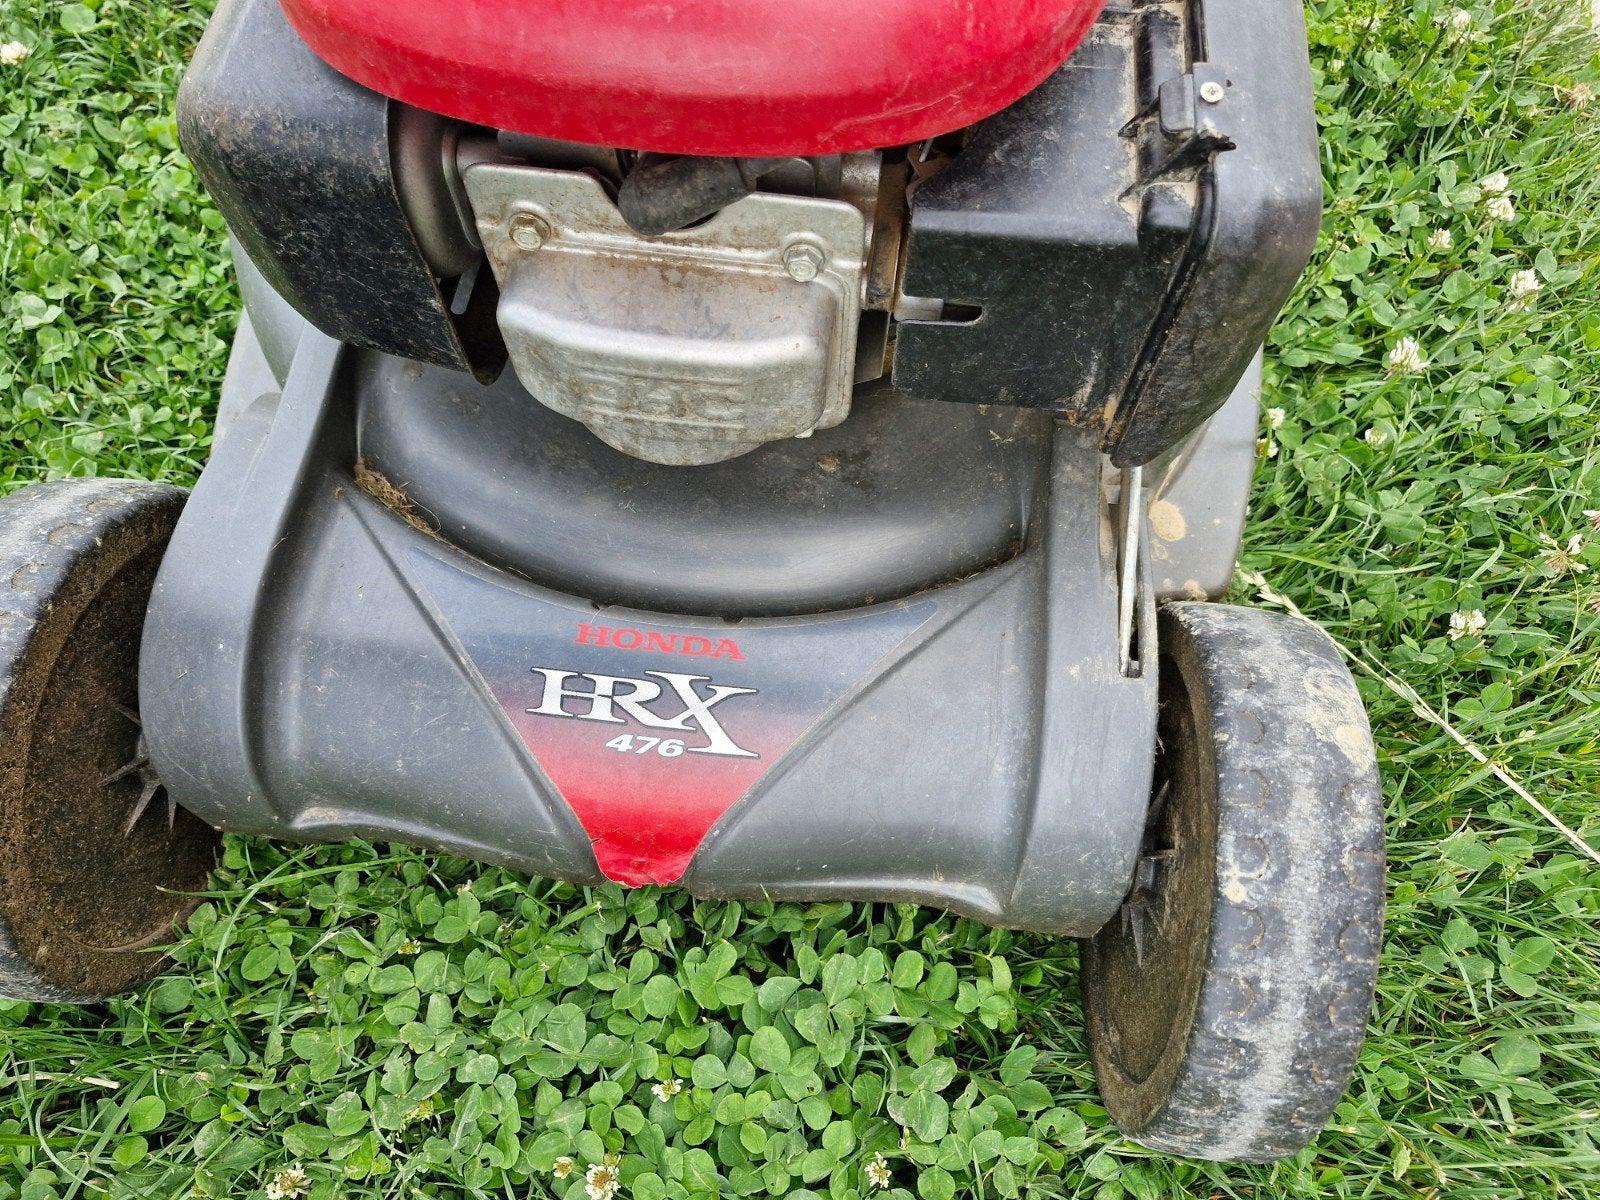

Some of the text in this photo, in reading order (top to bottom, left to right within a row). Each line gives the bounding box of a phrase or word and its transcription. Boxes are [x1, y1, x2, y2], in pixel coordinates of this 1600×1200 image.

[574, 623, 745, 661] HONDA
[525, 667, 760, 759] HRX
[606, 733, 685, 757] 476
